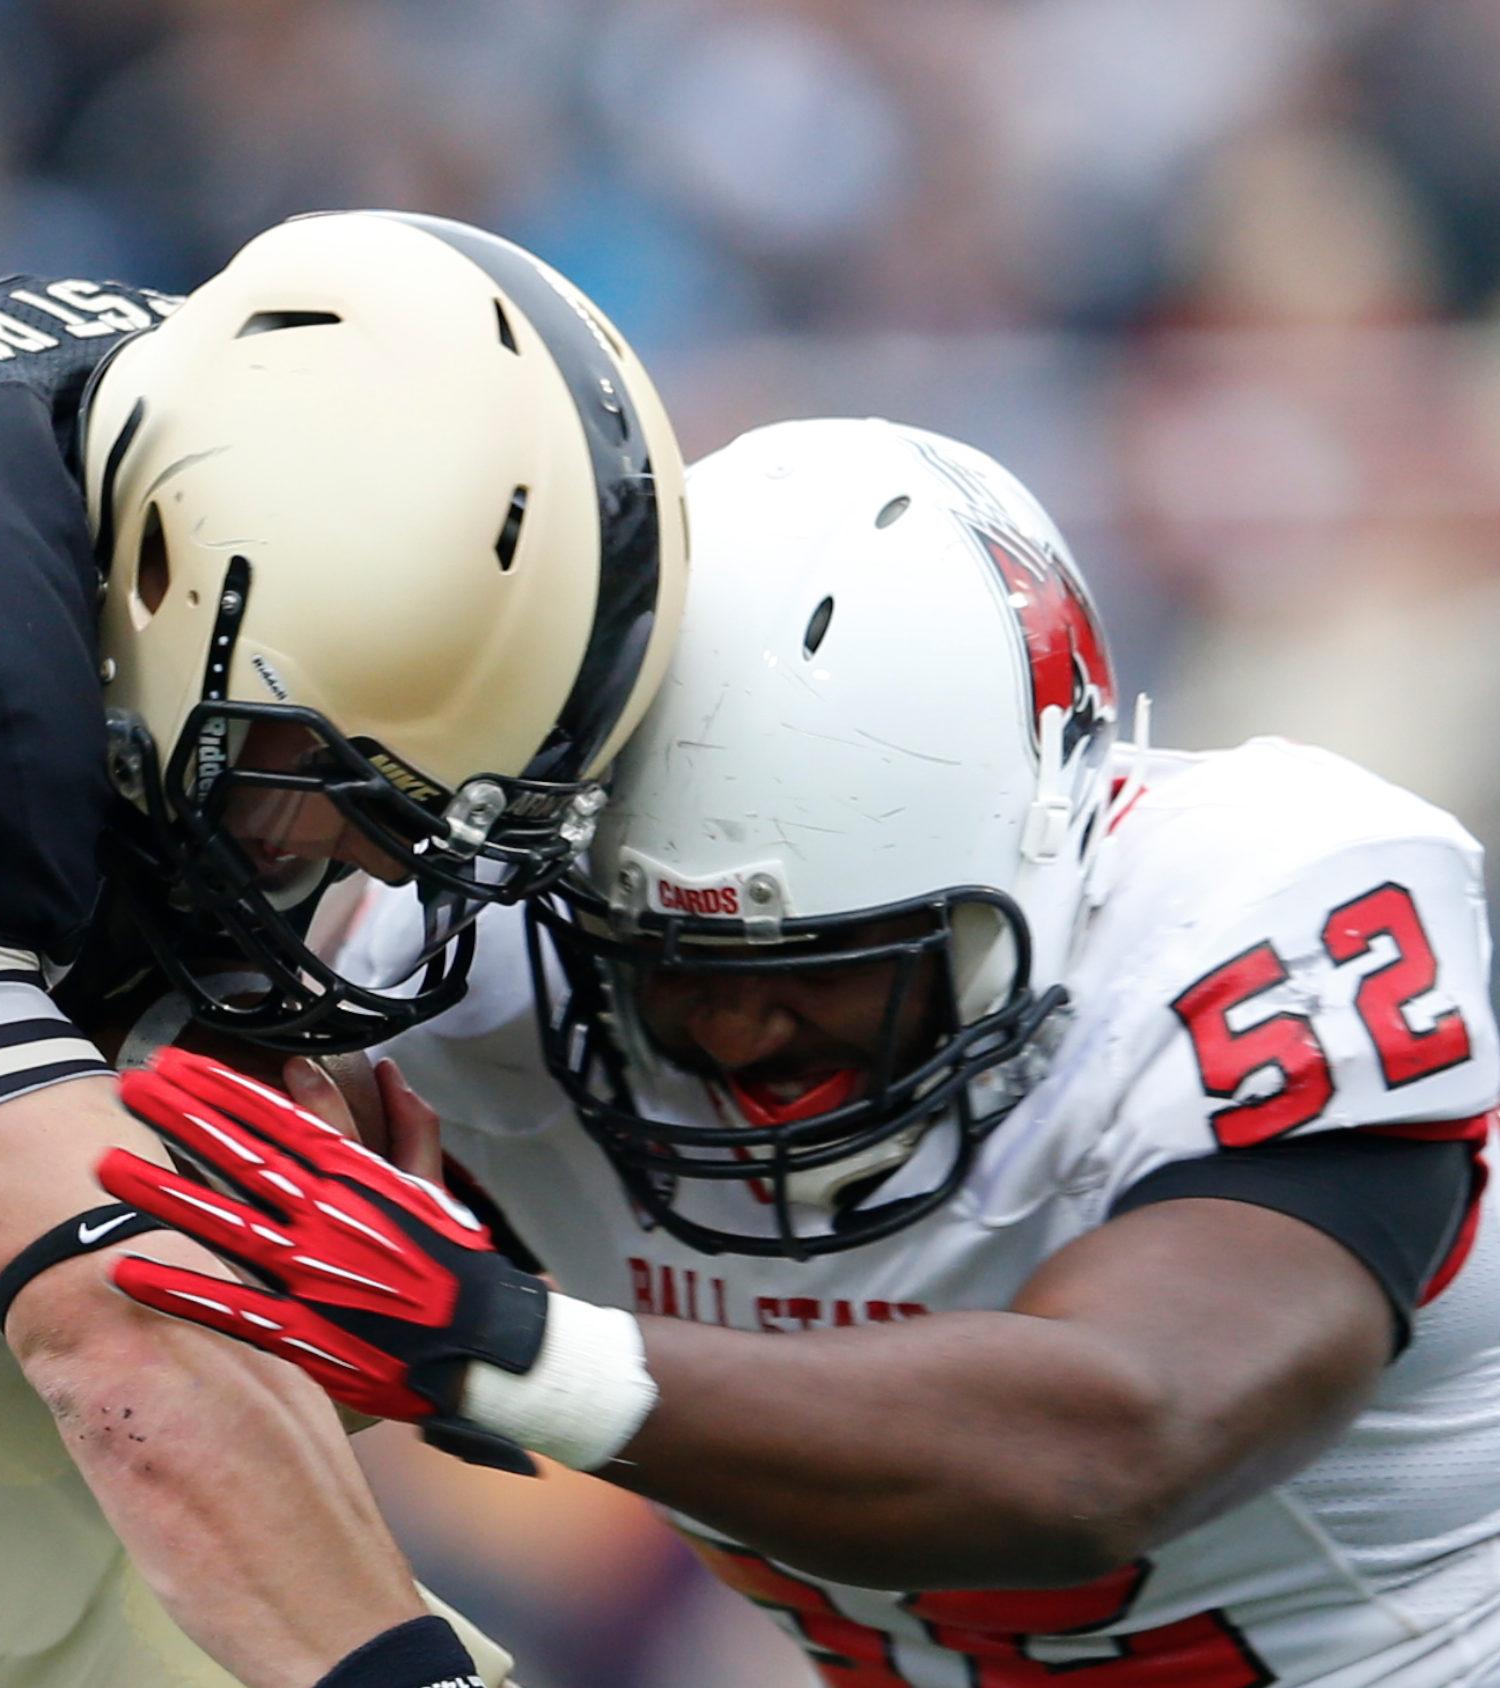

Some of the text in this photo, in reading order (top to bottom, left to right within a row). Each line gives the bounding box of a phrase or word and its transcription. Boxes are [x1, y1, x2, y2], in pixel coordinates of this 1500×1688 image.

[199, 716, 227, 802] Ridde
[658, 880, 739, 914] CARDS
[1170, 881, 1471, 1147] 52
